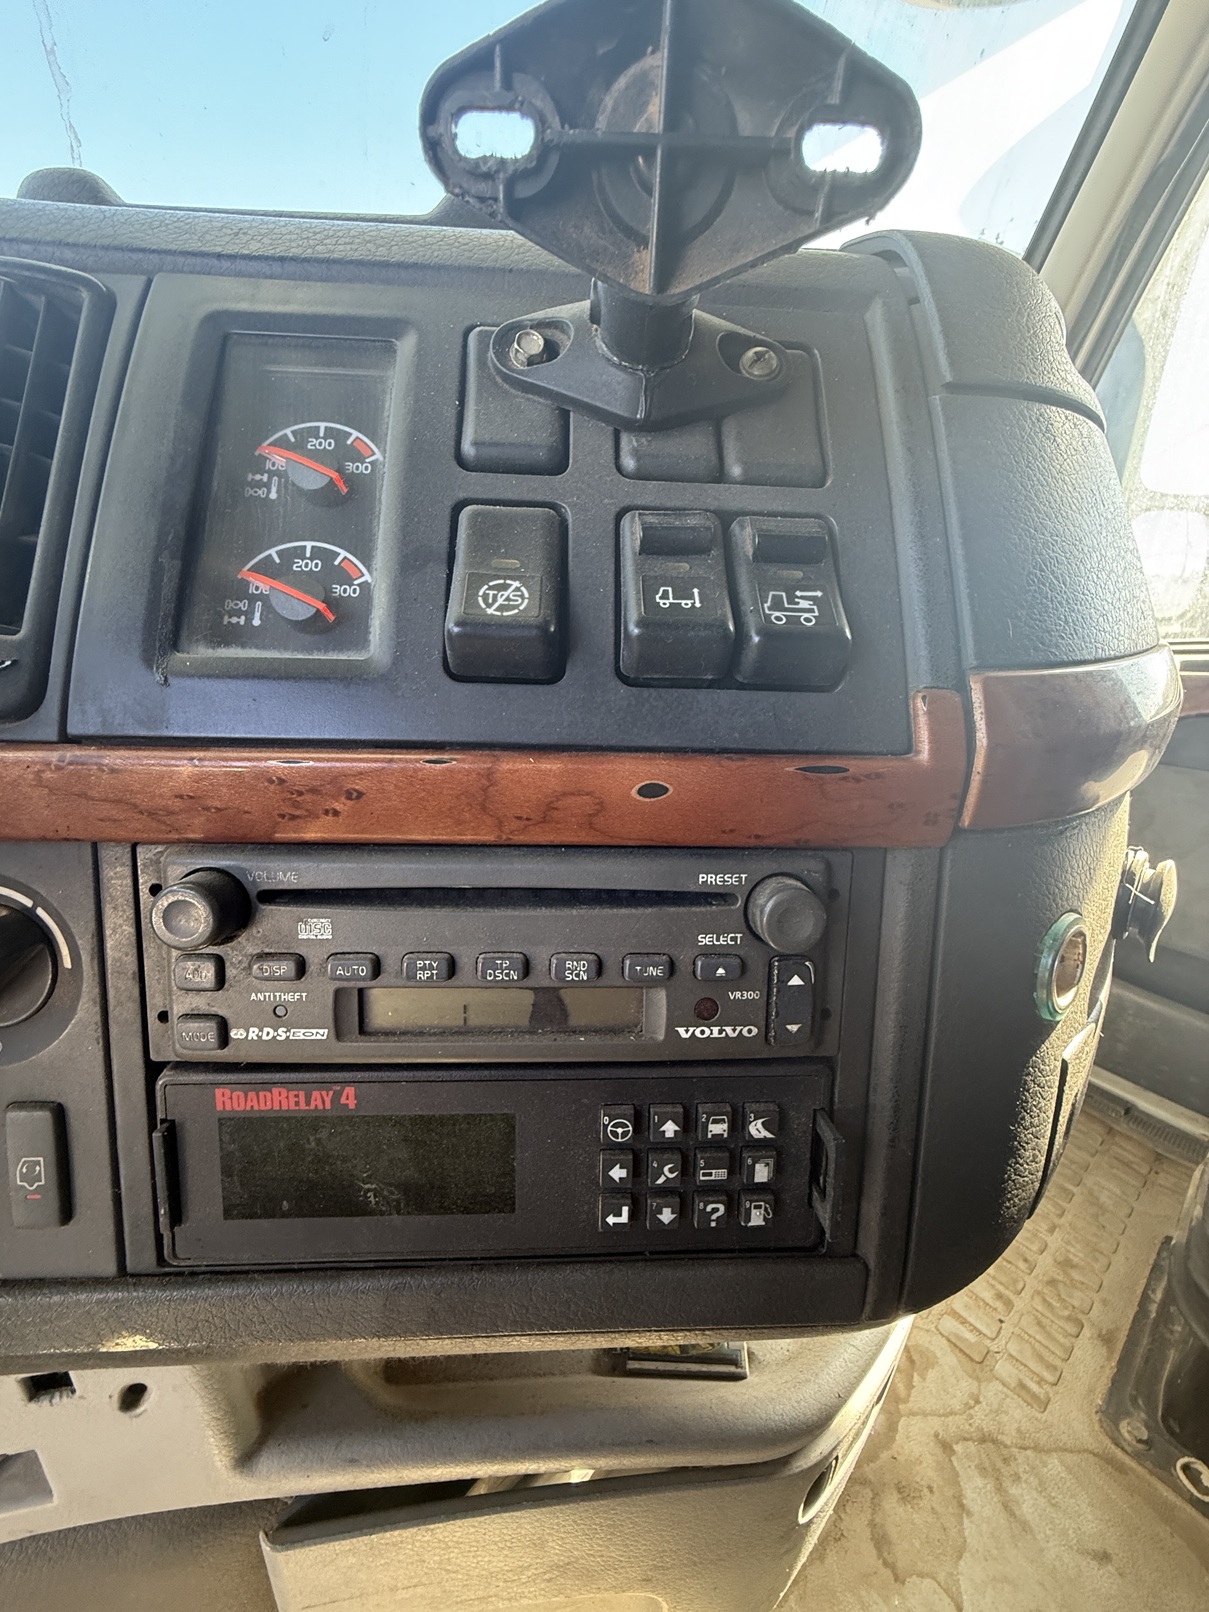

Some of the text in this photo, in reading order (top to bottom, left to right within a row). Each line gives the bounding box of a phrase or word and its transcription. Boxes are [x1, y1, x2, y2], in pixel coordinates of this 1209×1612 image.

[307, 438, 335, 450] 200
[345, 462, 371, 474] 300
[292, 559, 322, 572] 200
[332, 584, 360, 597] 300
[485, 590, 522, 605] TCS
[245, 870, 299, 883] VOLUME
[698, 873, 748, 886] PRESET
[697, 933, 743, 946] SELECT
[262, 965, 288, 976] DISP
[416, 960, 438, 970] PTY
[495, 960, 510, 969] TP
[565, 960, 588, 970] RND
[336, 966, 367, 976] AUTO
[416, 970, 438, 980] RPT
[486, 969, 518, 981] DSCN
[565, 970, 588, 981] SCN
[635, 966, 664, 976] TUNE
[250, 992, 308, 1002] ANTITHEFT
[728, 991, 761, 1000] VR300
[181, 1031, 216, 1043] MODE
[675, 1026, 759, 1039] VOLVO
[340, 1086, 357, 1110] 4
